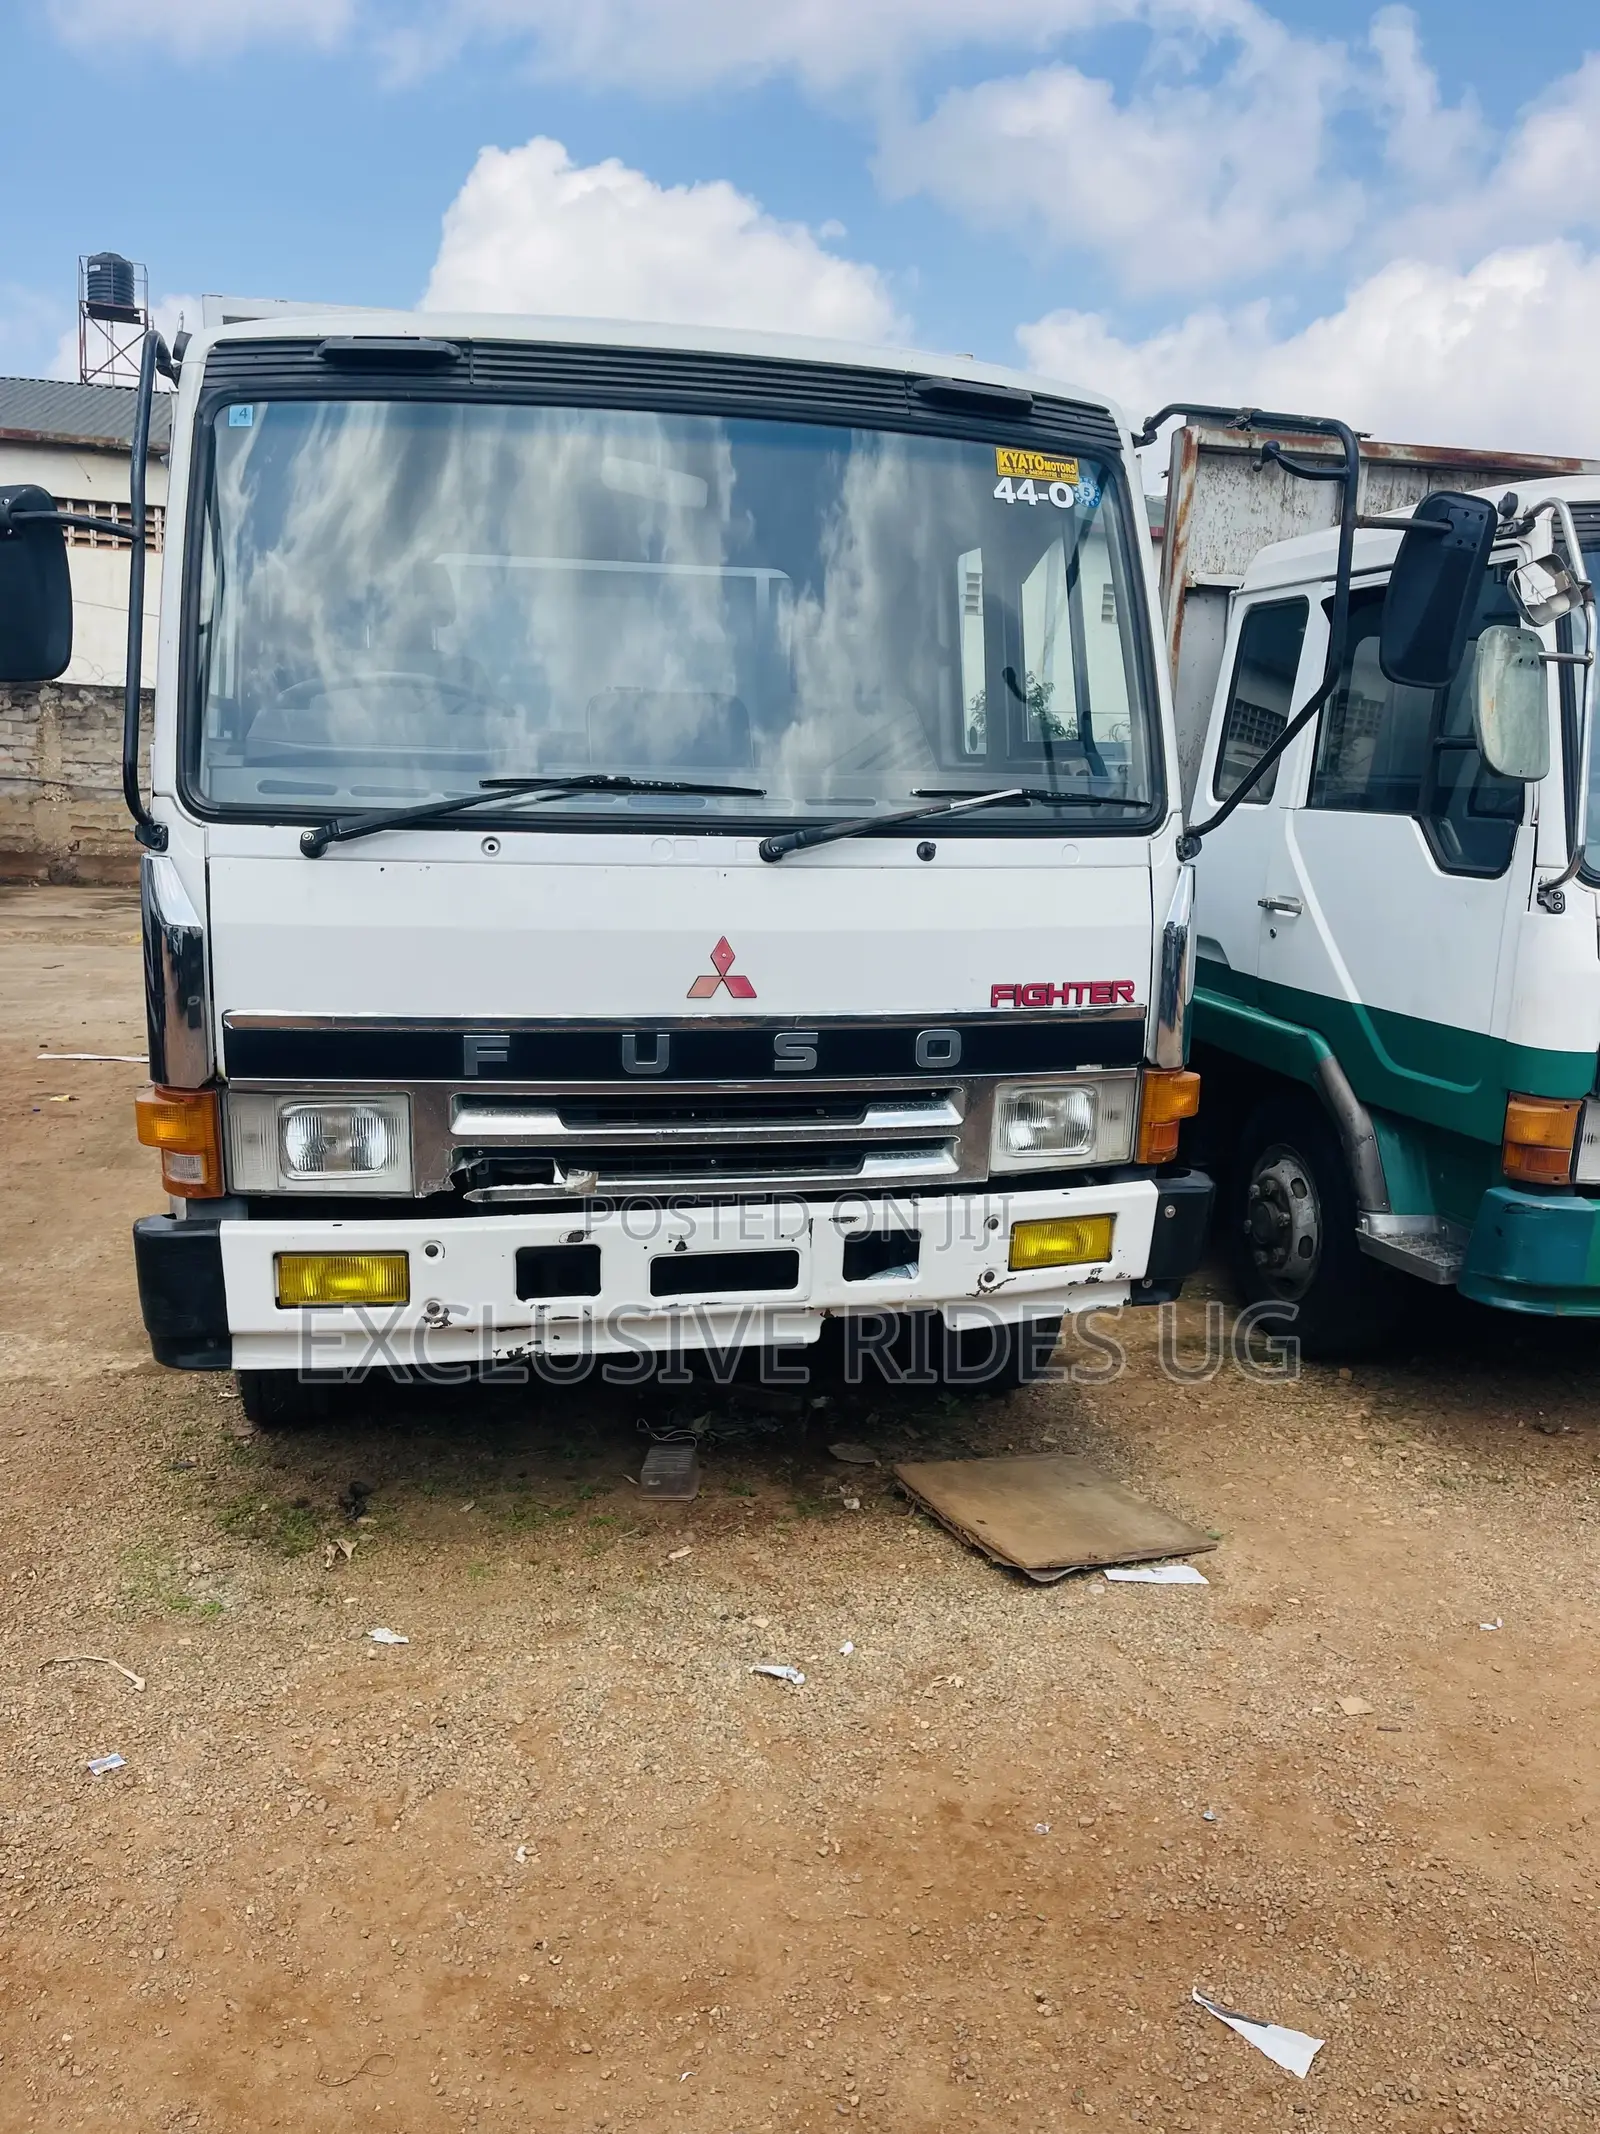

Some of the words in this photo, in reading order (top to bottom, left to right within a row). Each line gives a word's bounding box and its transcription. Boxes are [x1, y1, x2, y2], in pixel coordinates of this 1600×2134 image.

[239, 407, 248, 420] 4
[1000, 451, 1045, 470] KYATO
[1044, 461, 1076, 474] MOTORS
[1083, 487, 1091, 497] 5
[990, 979, 1136, 1008] FIGHTER
[463, 1029, 962, 1076] FUSO
